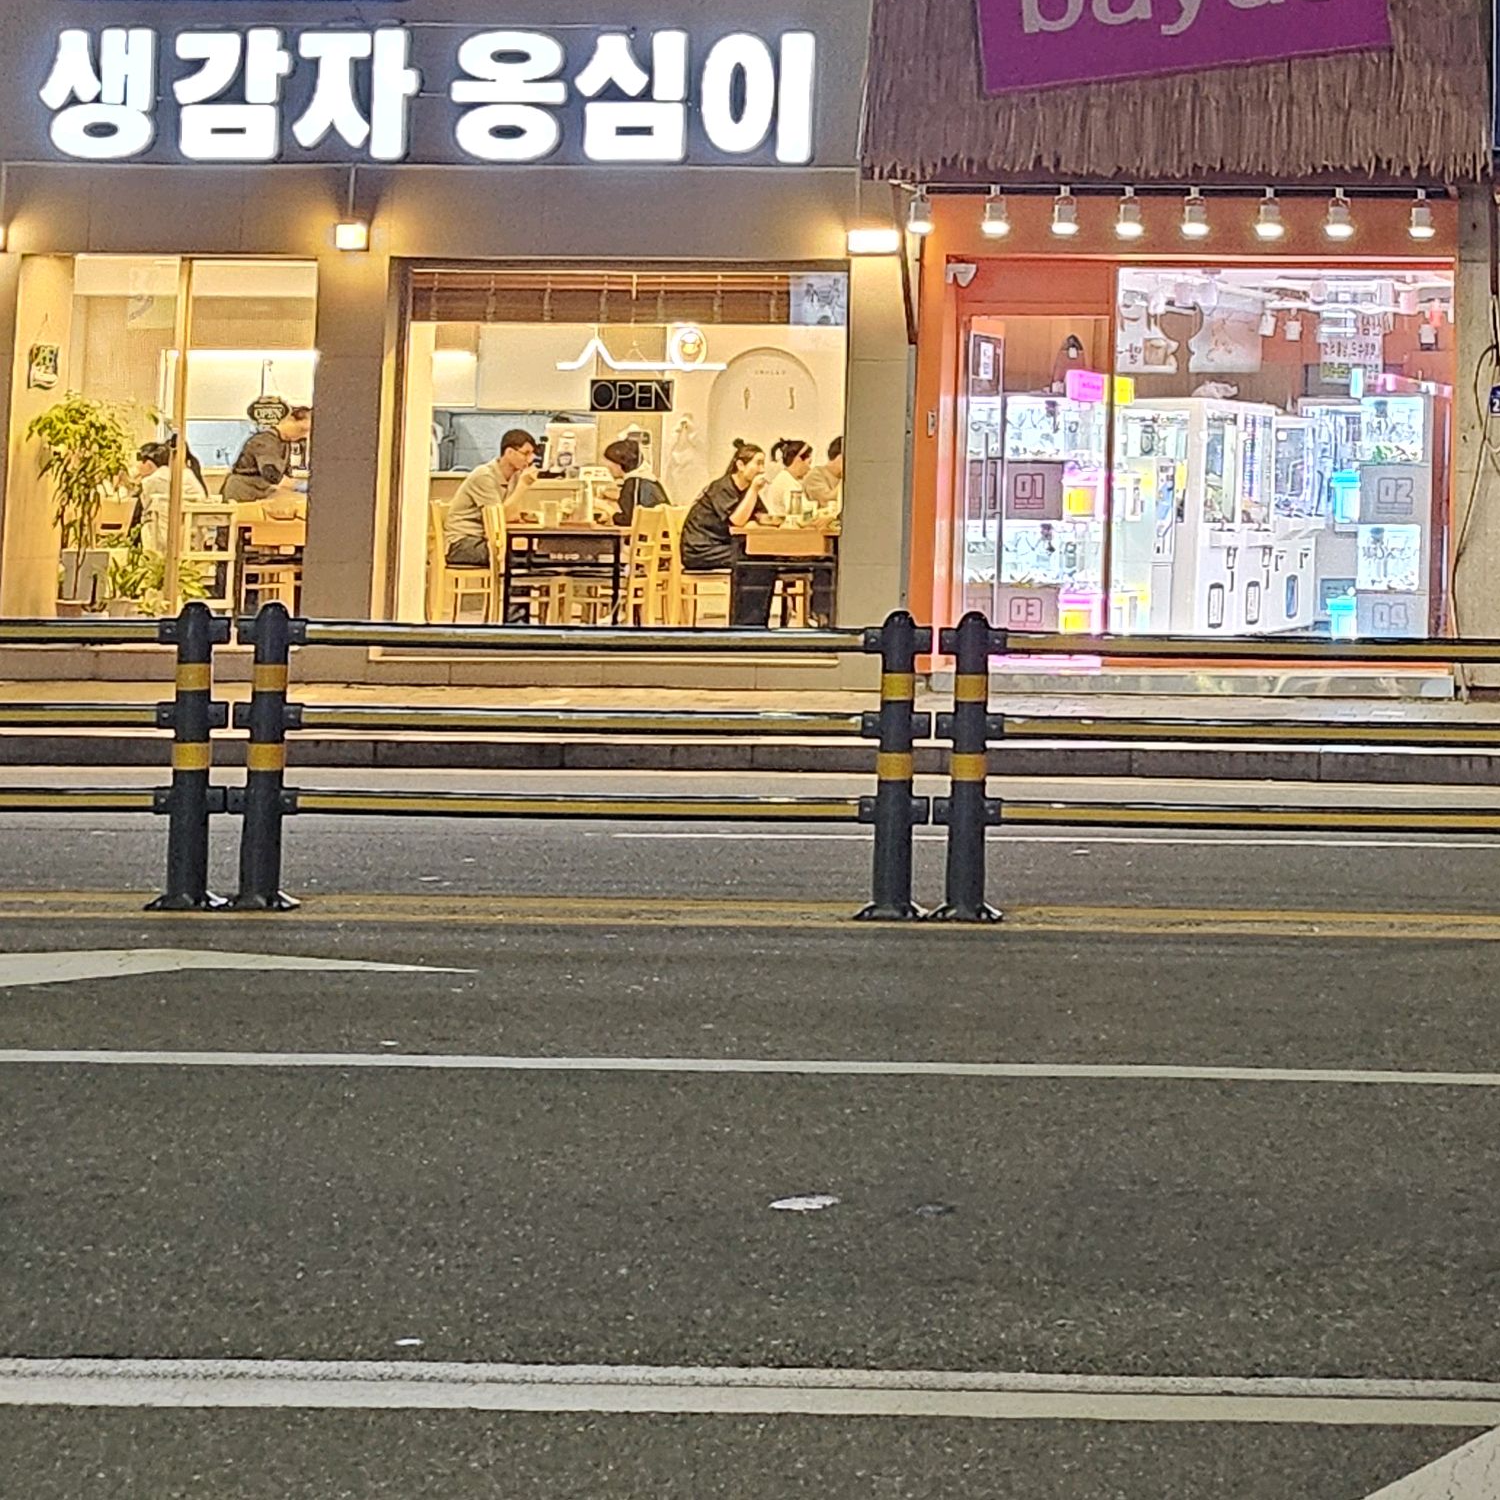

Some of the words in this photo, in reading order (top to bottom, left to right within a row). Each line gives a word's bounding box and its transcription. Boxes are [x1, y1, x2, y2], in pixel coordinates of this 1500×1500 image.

[40, 27, 417, 162] 생감자
[450, 30, 816, 163] 옹심이
[592, 381, 673, 409] OPEN
